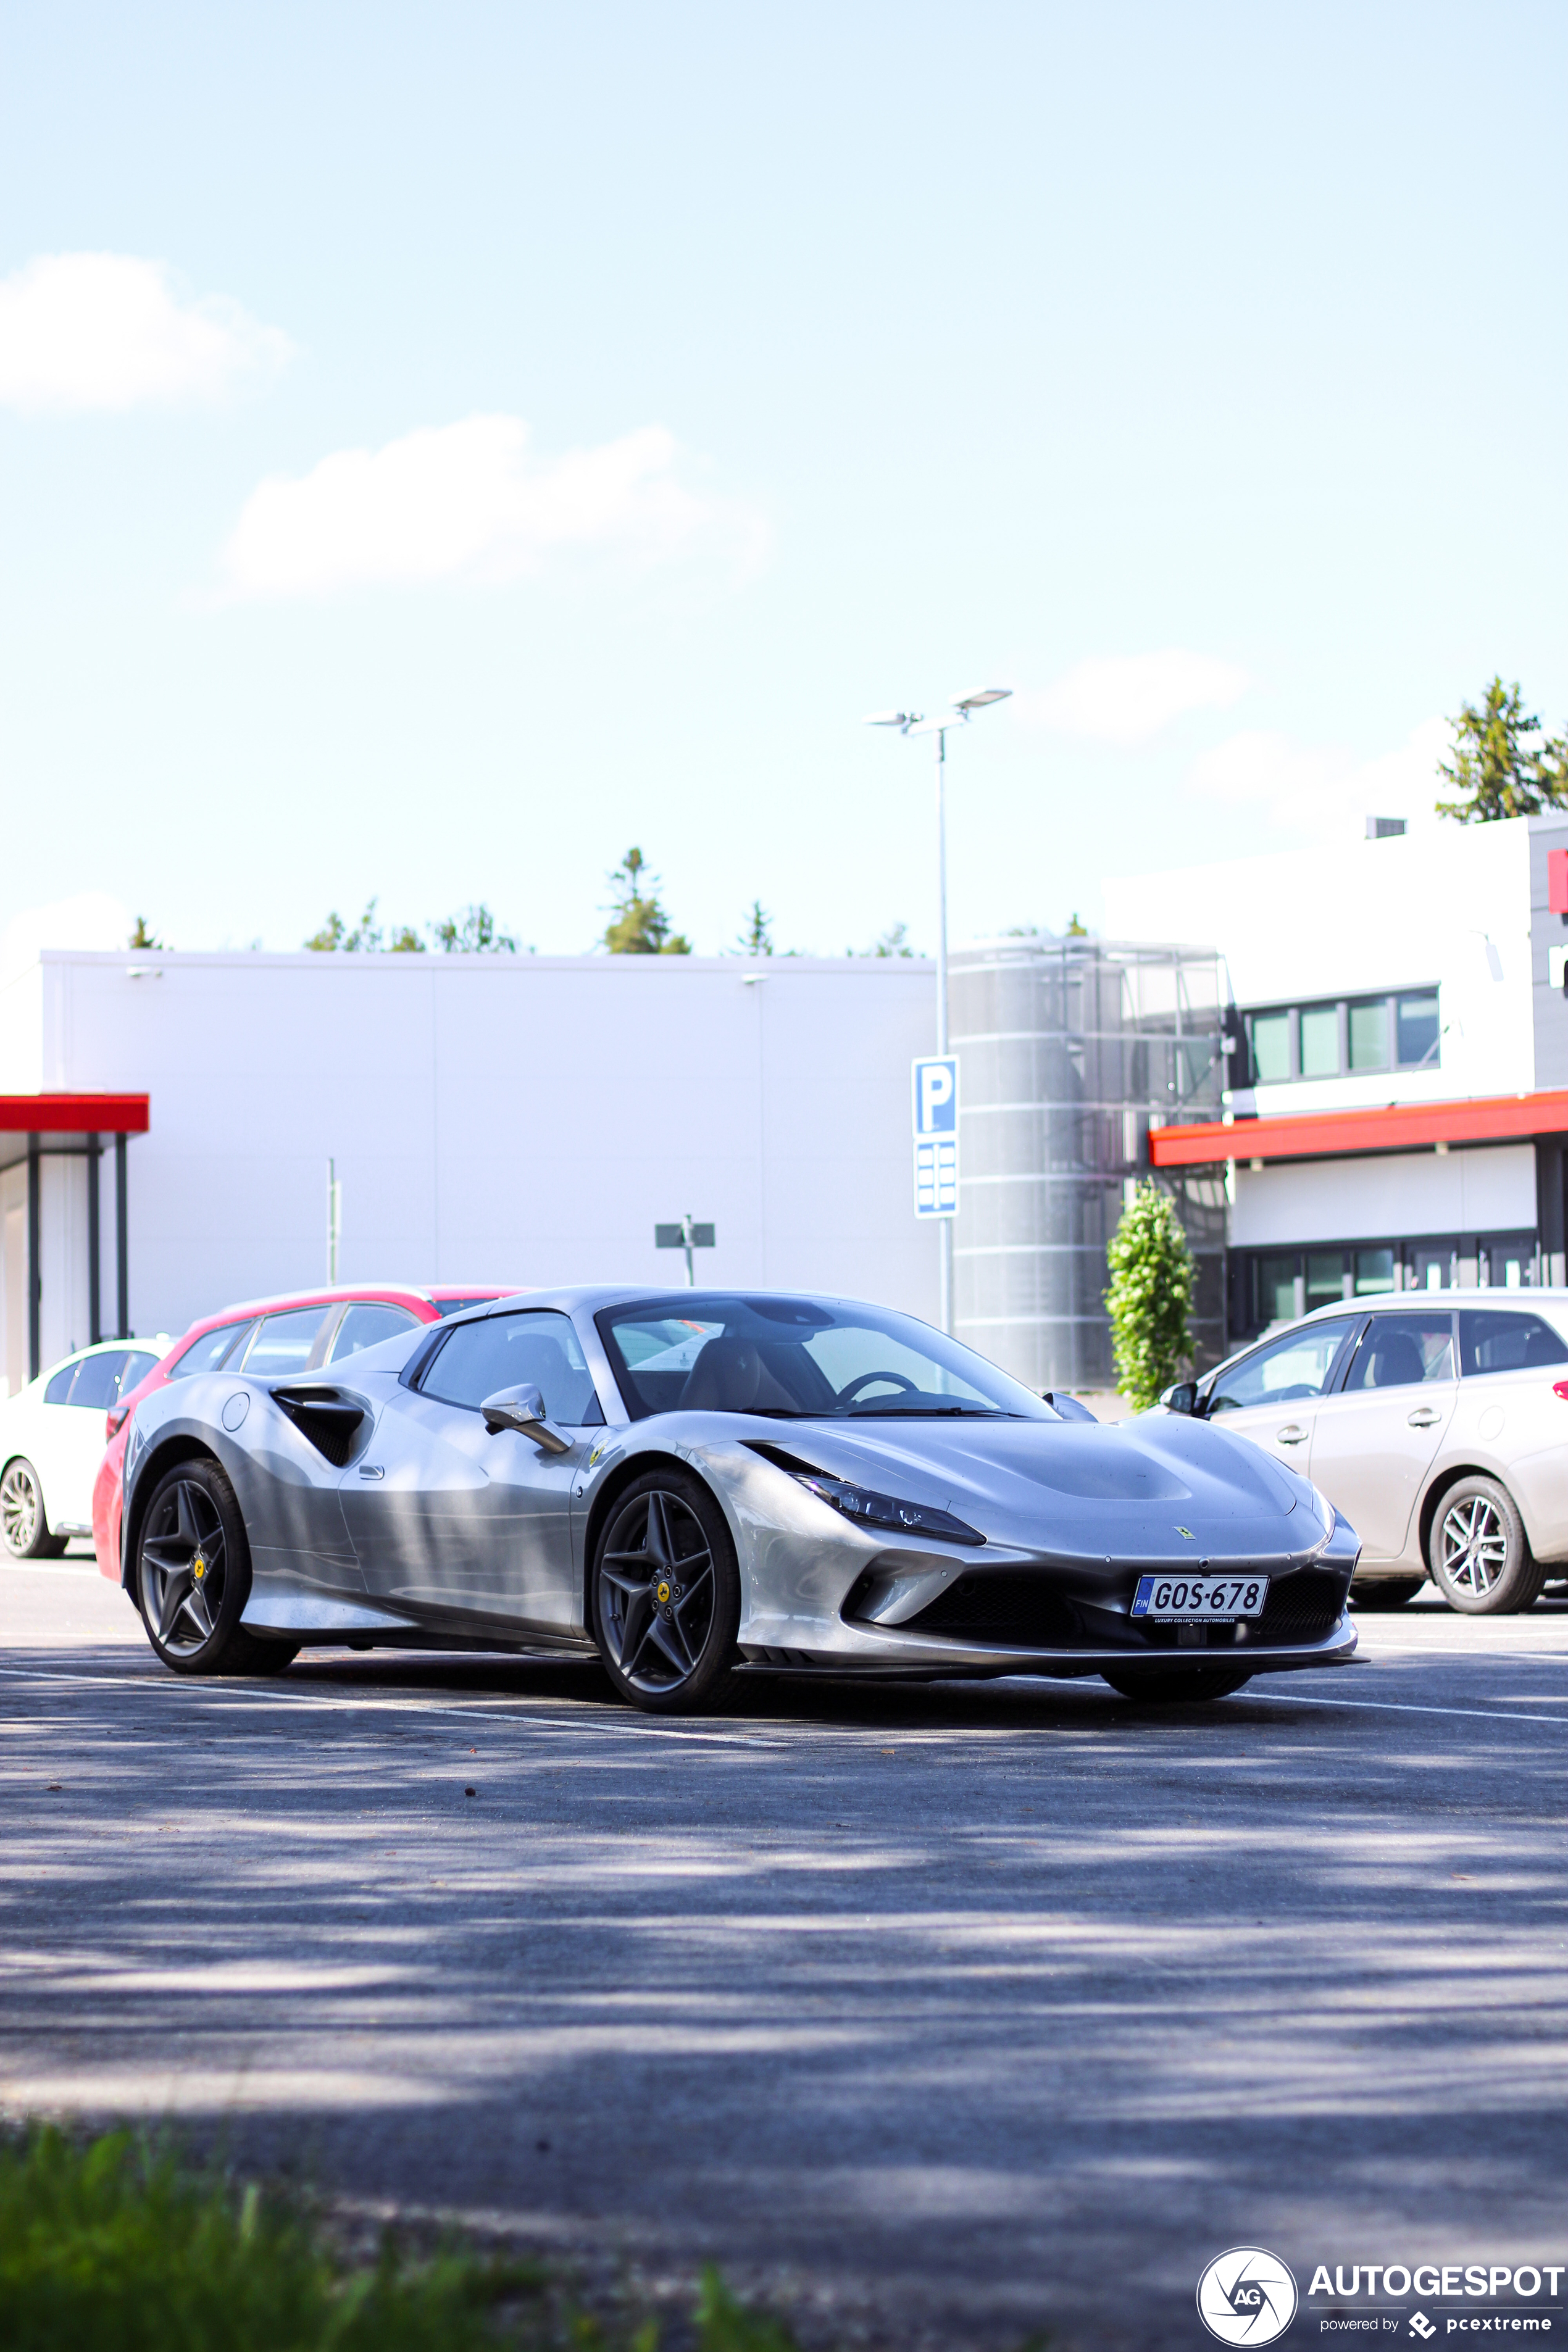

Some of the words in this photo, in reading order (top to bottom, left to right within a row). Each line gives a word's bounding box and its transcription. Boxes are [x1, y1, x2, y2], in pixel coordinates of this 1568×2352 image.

[921, 1065, 953, 1132] P
[1135, 1599, 1149, 1608] FIN
[1154, 1582, 1259, 1609] GOS-678
